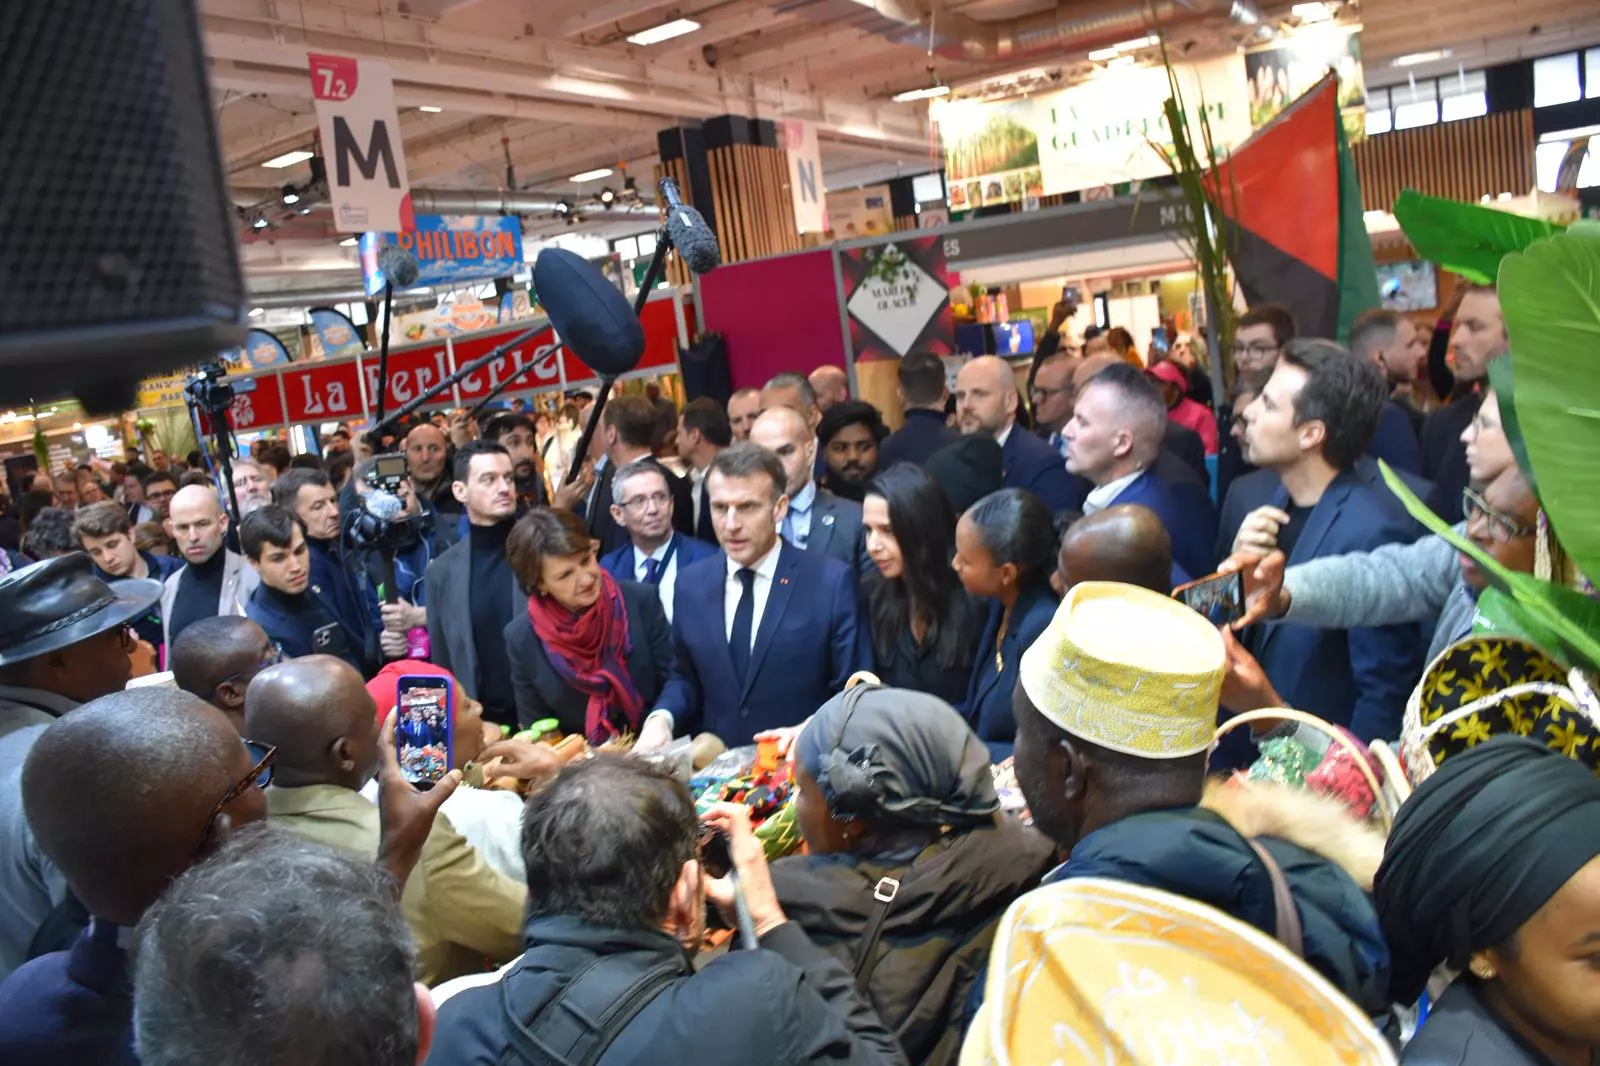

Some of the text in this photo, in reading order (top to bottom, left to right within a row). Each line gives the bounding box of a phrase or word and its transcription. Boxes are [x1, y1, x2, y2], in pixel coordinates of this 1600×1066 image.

[317, 67, 348, 98] 7.2
[333, 116, 401, 188] M
[797, 158, 818, 205] N
[397, 230, 515, 261] PHILIBON
[301, 374, 348, 415] La
